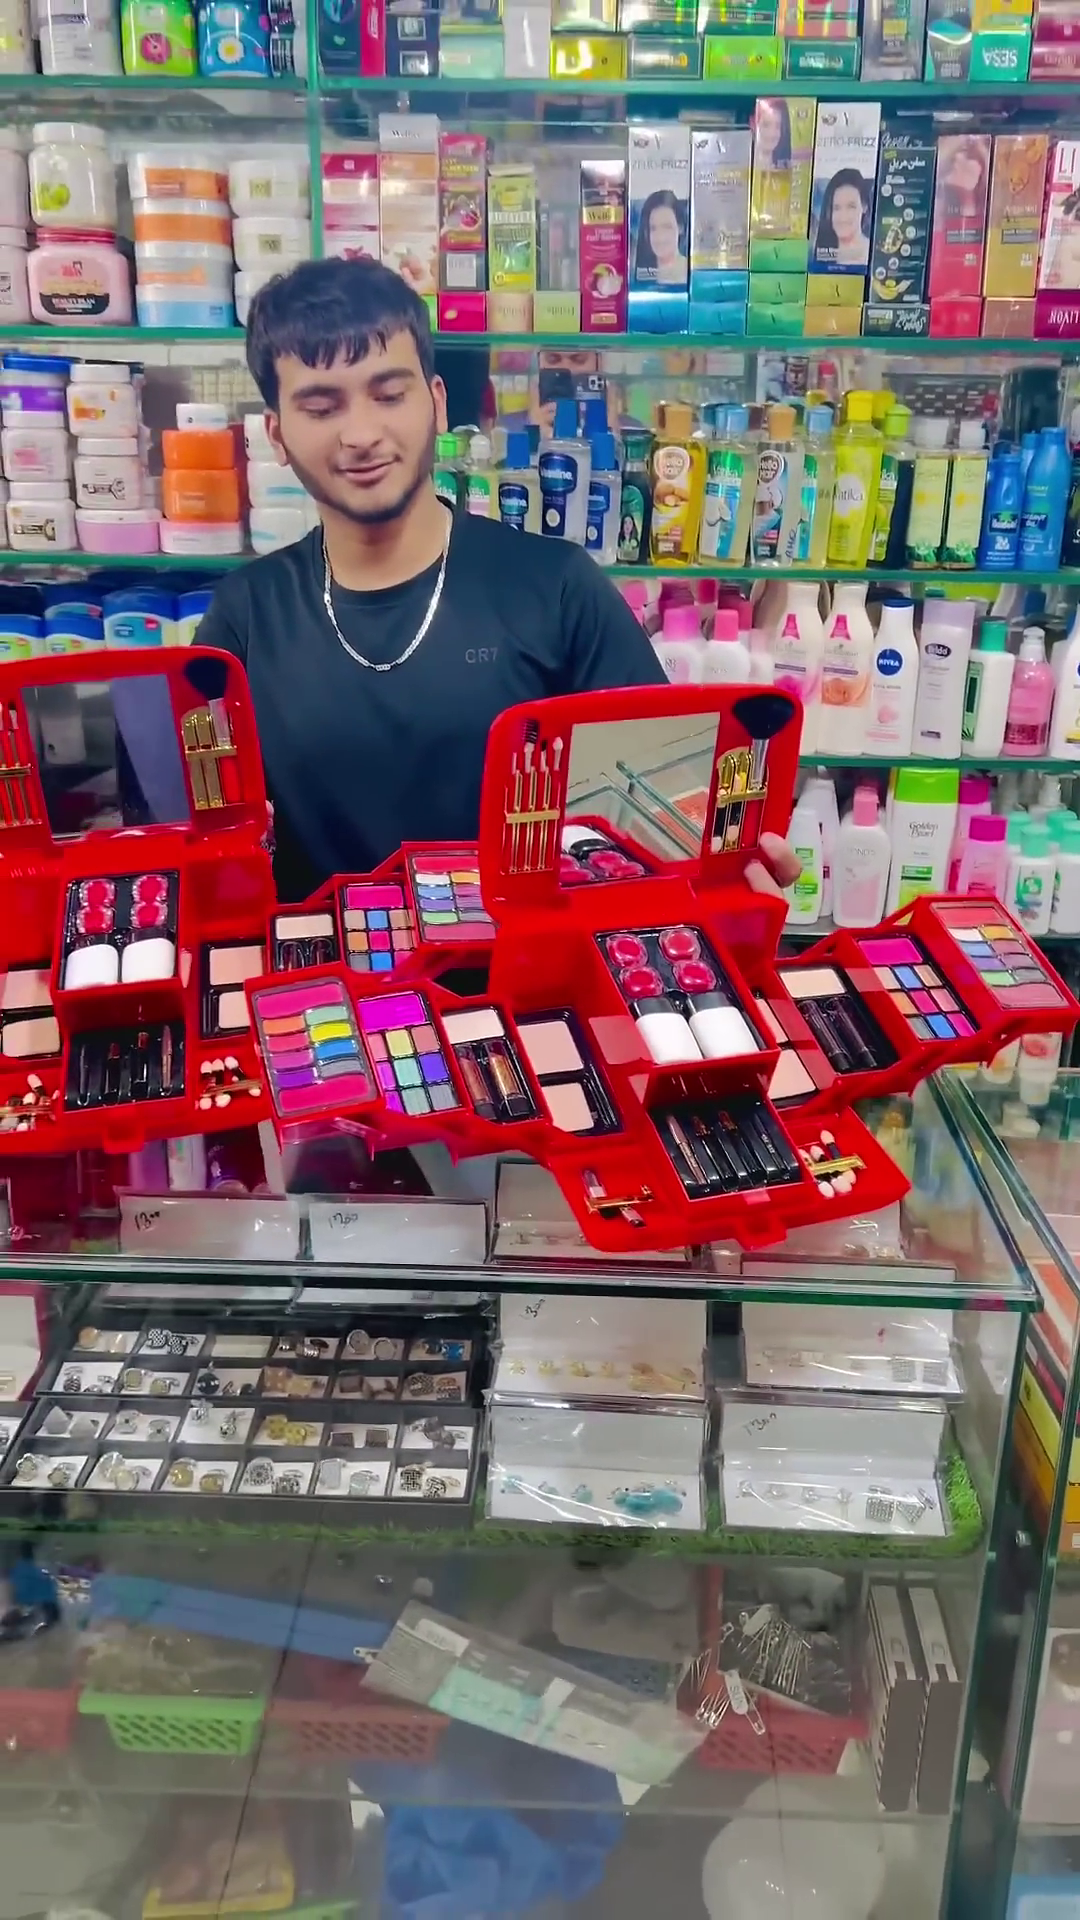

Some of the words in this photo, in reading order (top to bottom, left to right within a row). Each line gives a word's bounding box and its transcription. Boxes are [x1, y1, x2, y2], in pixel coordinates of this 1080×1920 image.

[983, 47, 1018, 66] SESA
[465, 647, 498, 664] CR7
[878, 658, 900, 667] NIVEA
[909, 821, 939, 831] Golden
